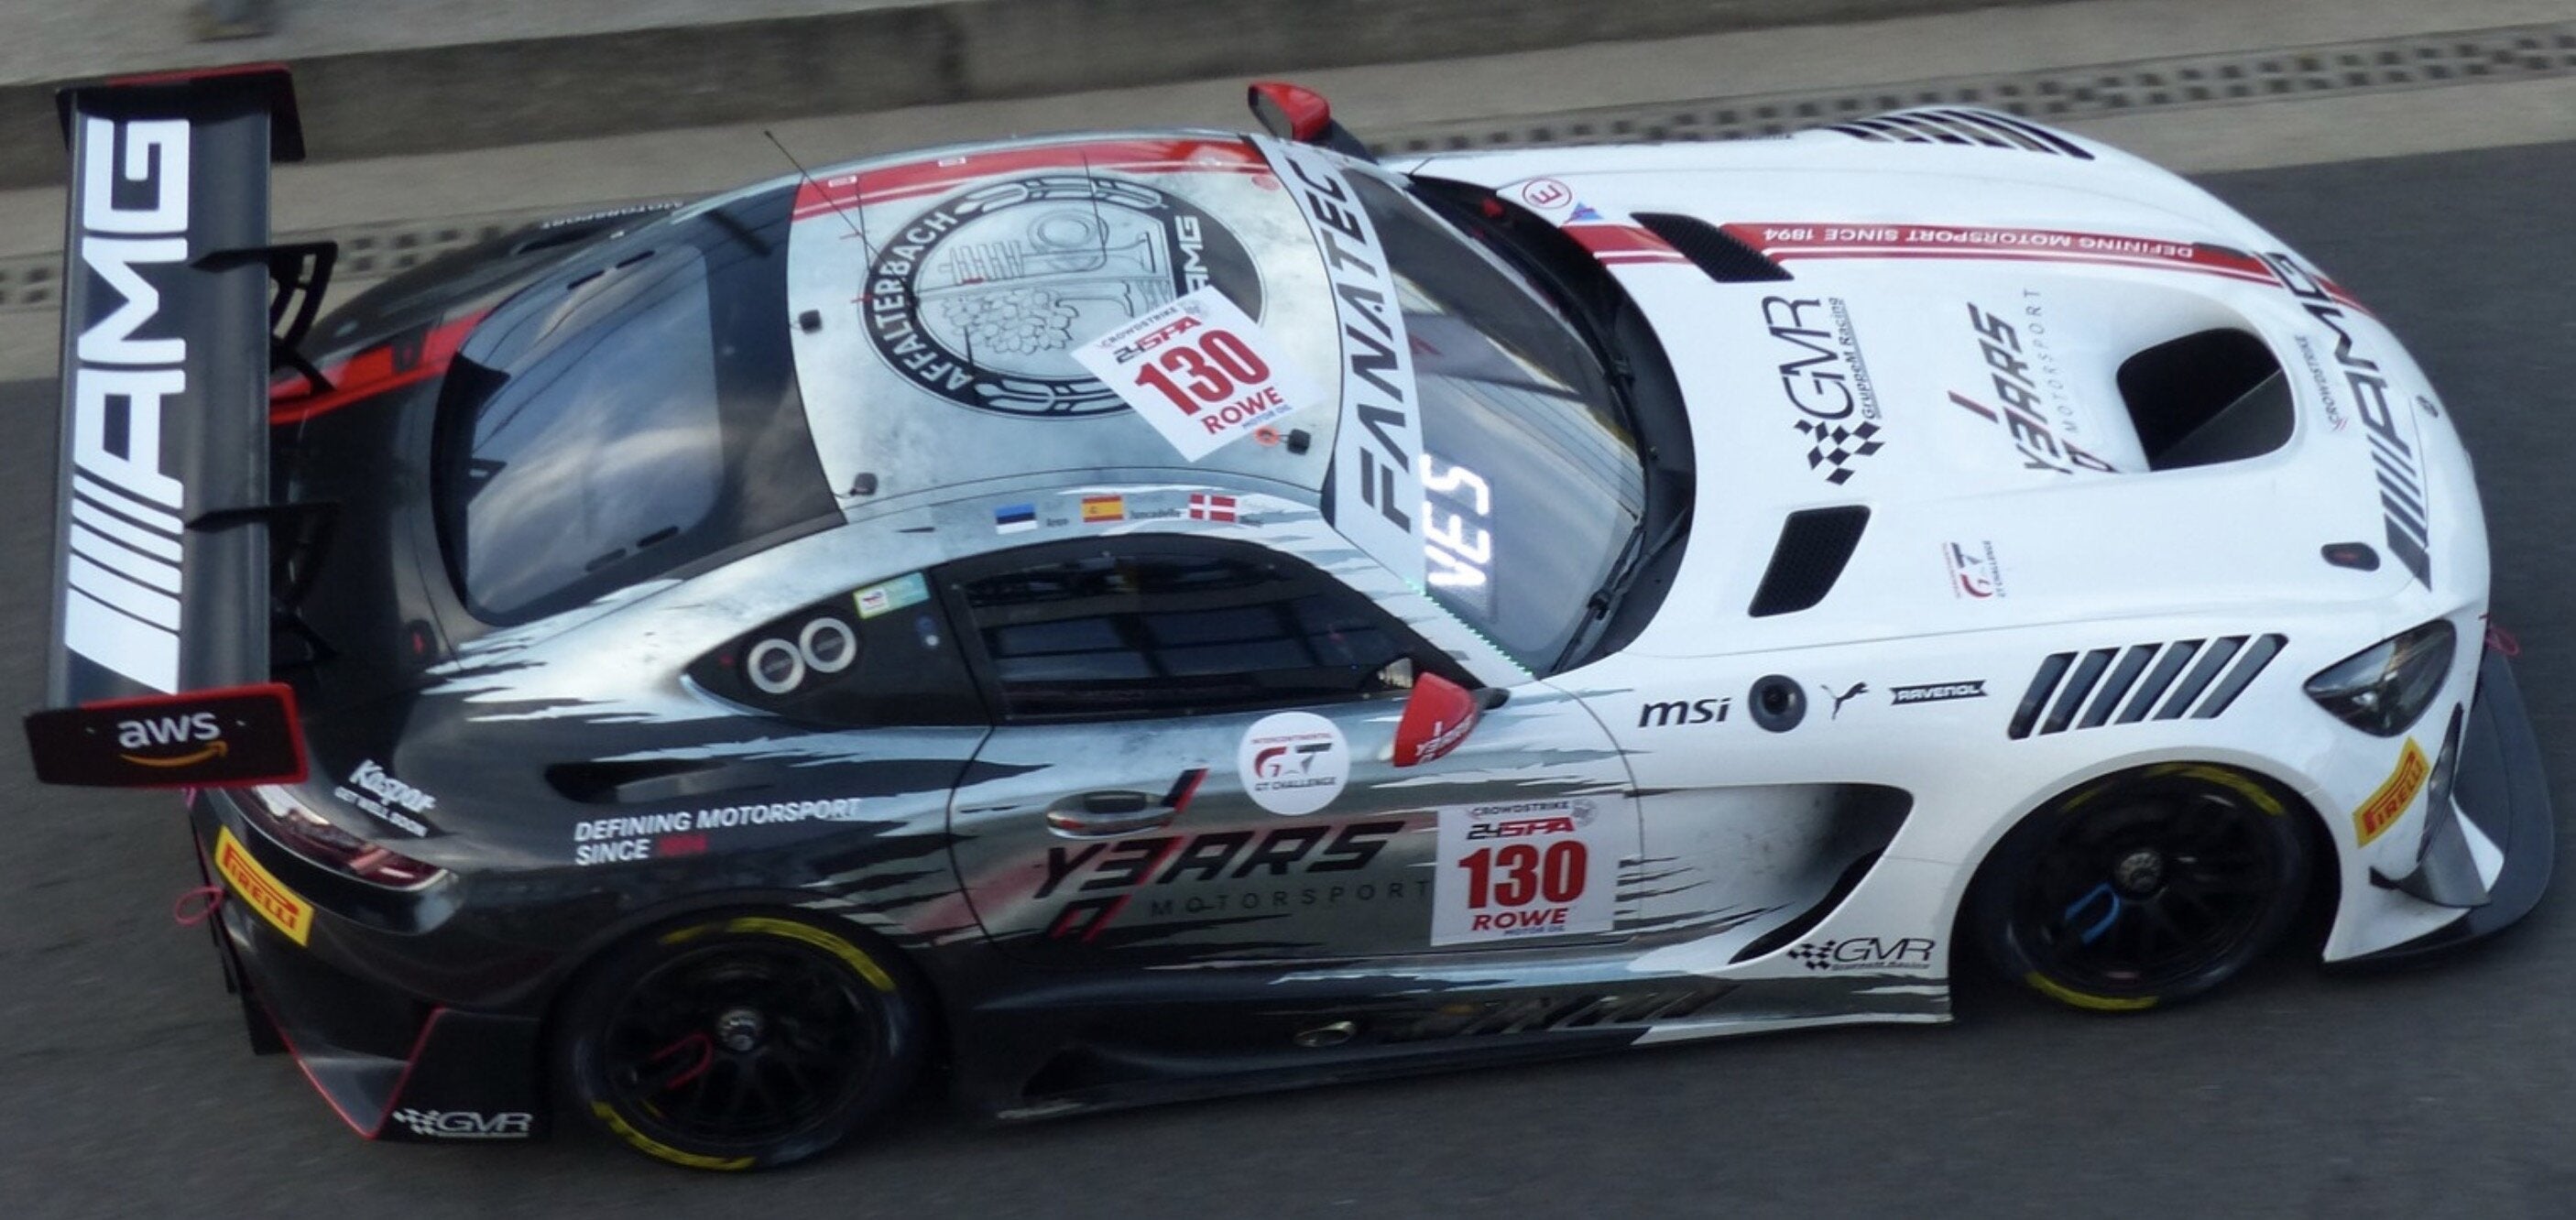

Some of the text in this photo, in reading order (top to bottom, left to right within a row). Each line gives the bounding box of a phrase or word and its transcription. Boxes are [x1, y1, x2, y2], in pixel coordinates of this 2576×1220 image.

[1763, 228, 2194, 258] DEFINING MOTORSPORT SINCE 1894
[872, 211, 975, 390] AFFALTERBACH
[1286, 156, 1412, 534] FANATEC
[1762, 296, 1854, 420] GMR
[2024, 289, 2079, 434] MOTORSPORT
[1134, 330, 1271, 416] 130
[1201, 387, 1284, 434] ROWE
[117, 712, 221, 748] aws
[1638, 697, 1732, 727] msi
[2362, 750, 2424, 836] PIRELLI
[574, 798, 862, 843] DEFINING MOTORSPORT
[575, 839, 651, 866] SINCE
[1457, 840, 1588, 910] 130
[223, 842, 300, 931] PIRELLI
[1151, 880, 1431, 917] MOTORSPORT
[1471, 908, 1569, 931] ROWE
[1834, 937, 1937, 963] GMR
[435, 1111, 533, 1132] GMR
